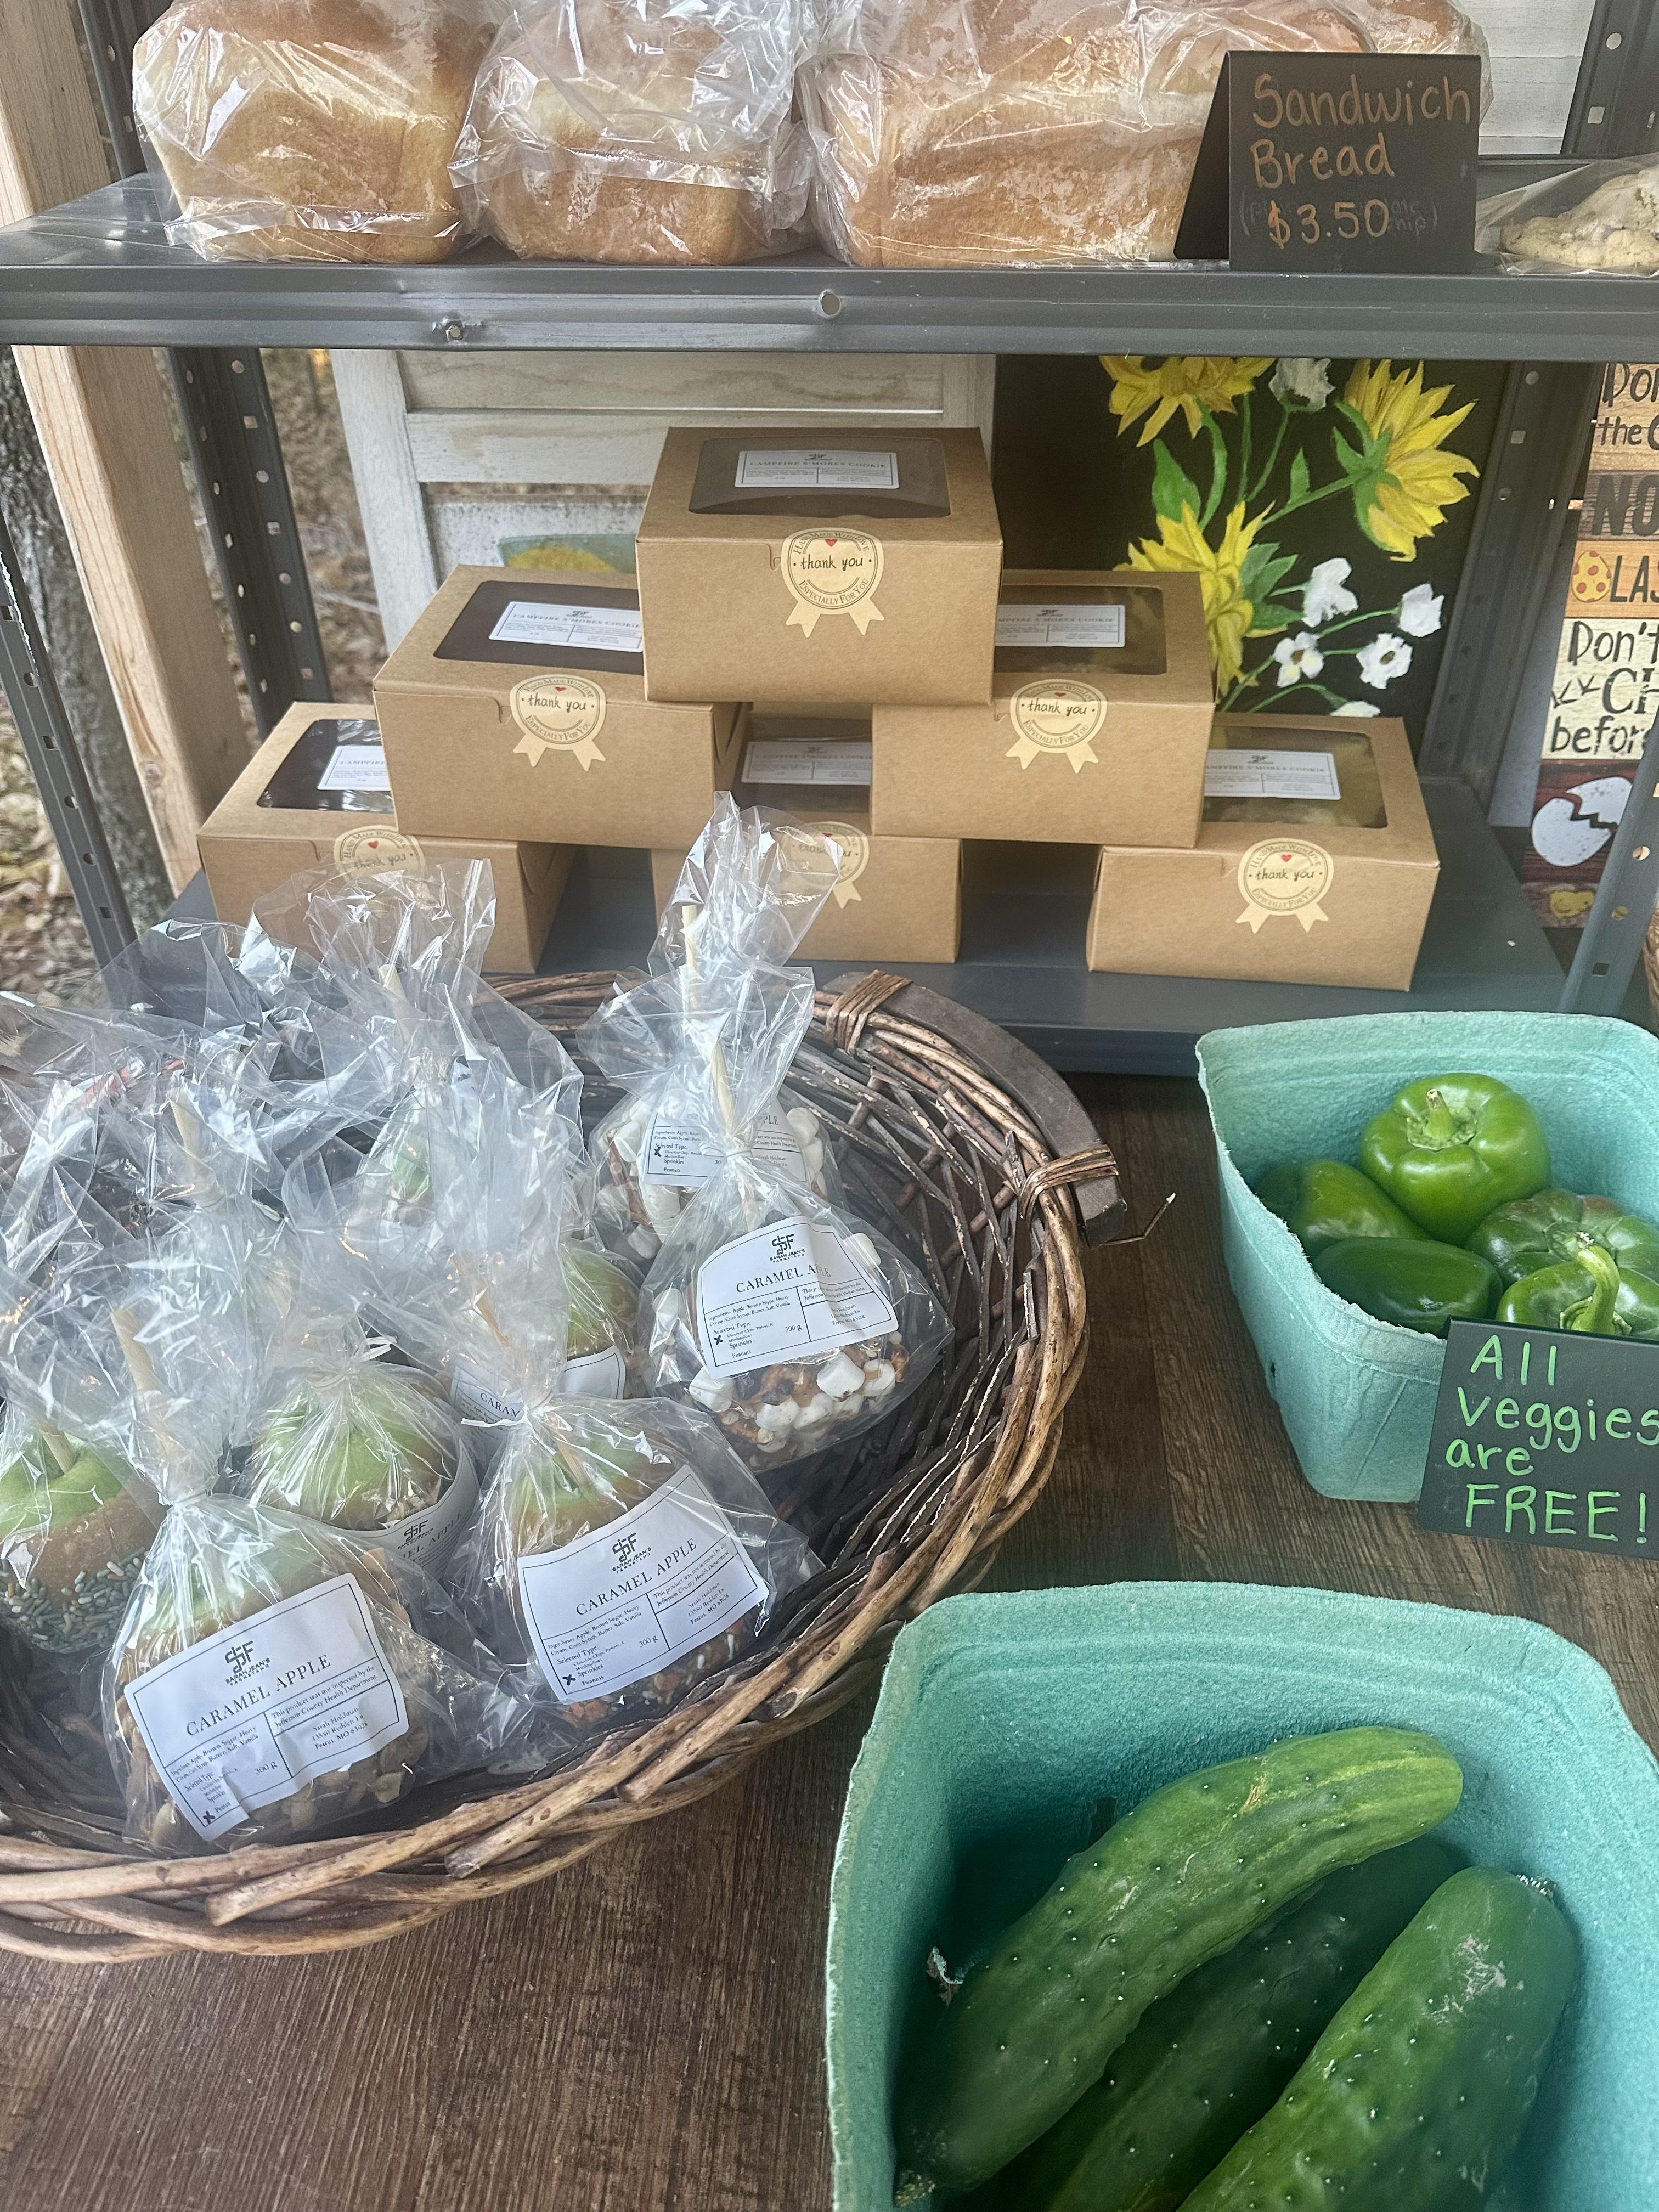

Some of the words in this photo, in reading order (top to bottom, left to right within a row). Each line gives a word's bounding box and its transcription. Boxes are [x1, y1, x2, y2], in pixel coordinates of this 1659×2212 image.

[1253, 74, 1470, 128] Sandwich
[1250, 132, 1395, 188] Bread
[1268, 199, 1390, 249] $3.50
[1599, 416, 1642, 445] the
[800, 554, 837, 570] thank
[842, 557, 863, 571] you
[1567, 620, 1659, 666] Don't
[528, 692, 561, 709] thank
[566, 701, 586, 713] you
[1028, 697, 1061, 714] thank
[1066, 706, 1087, 716] you
[1550, 715, 1653, 755] befor
[388, 853, 407, 866] you
[1256, 868, 1288, 880] thank
[1294, 871, 1314, 882] you
[736, 1267, 803, 1293] CARAMEL
[729, 1339, 753, 1350] Sprinkles
[1470, 1334, 1557, 1386] All
[481, 1392, 520, 1417] CARAM
[1457, 1386, 1659, 1453] Veggies
[1445, 1438, 1534, 1476] are
[1465, 1483, 1647, 1544] FREE!
[576, 1572, 653, 1615] CARAMEL
[657, 1538, 697, 1576] APPLE
[639, 1637, 651, 1648] 300
[557, 1652, 581, 1665] Selected
[577, 1664, 603, 1677] Sprinkles
[582, 1675, 604, 1686] Peanuts
[186, 1684, 270, 1736] CARAMEL
[276, 1654, 331, 1691] APPLE
[337, 1731, 349, 1740] MO
[255, 1764, 269, 1775] 300
